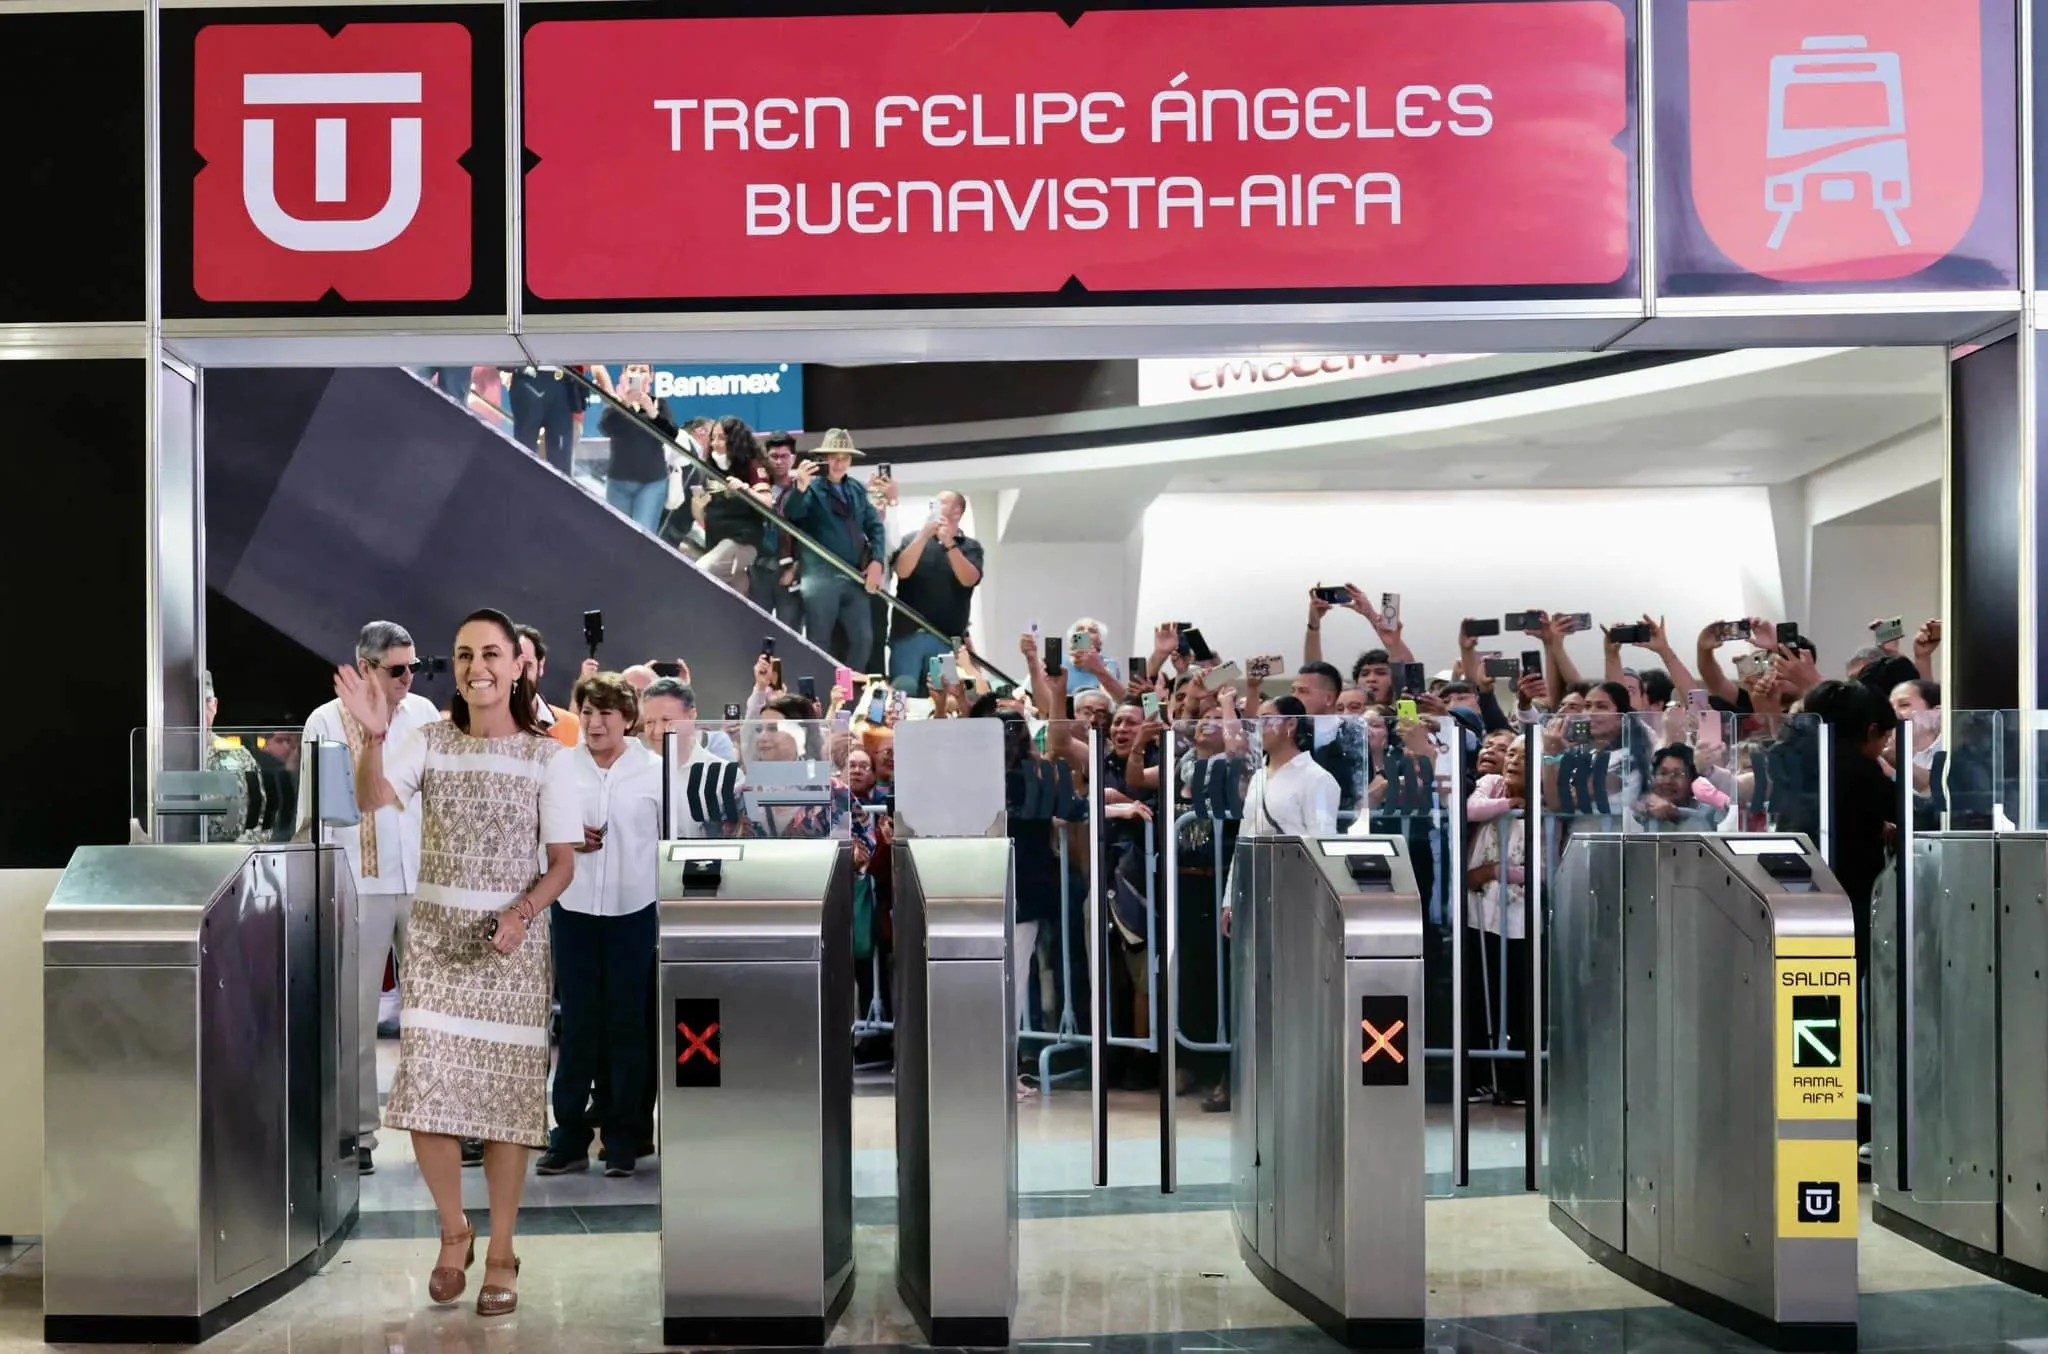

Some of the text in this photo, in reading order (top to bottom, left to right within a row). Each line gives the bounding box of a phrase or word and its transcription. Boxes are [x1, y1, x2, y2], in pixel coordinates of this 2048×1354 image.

[653, 71, 1495, 152] TREN FELIPE ÁNGELES
[745, 172, 1402, 237] BUENAVISTA-AIFA
[654, 371, 780, 398] Banamex
[1782, 972, 1851, 987] SALIDA
[1793, 1076, 1843, 1088] RAMAL
[1802, 1093, 1834, 1104] AIFA
